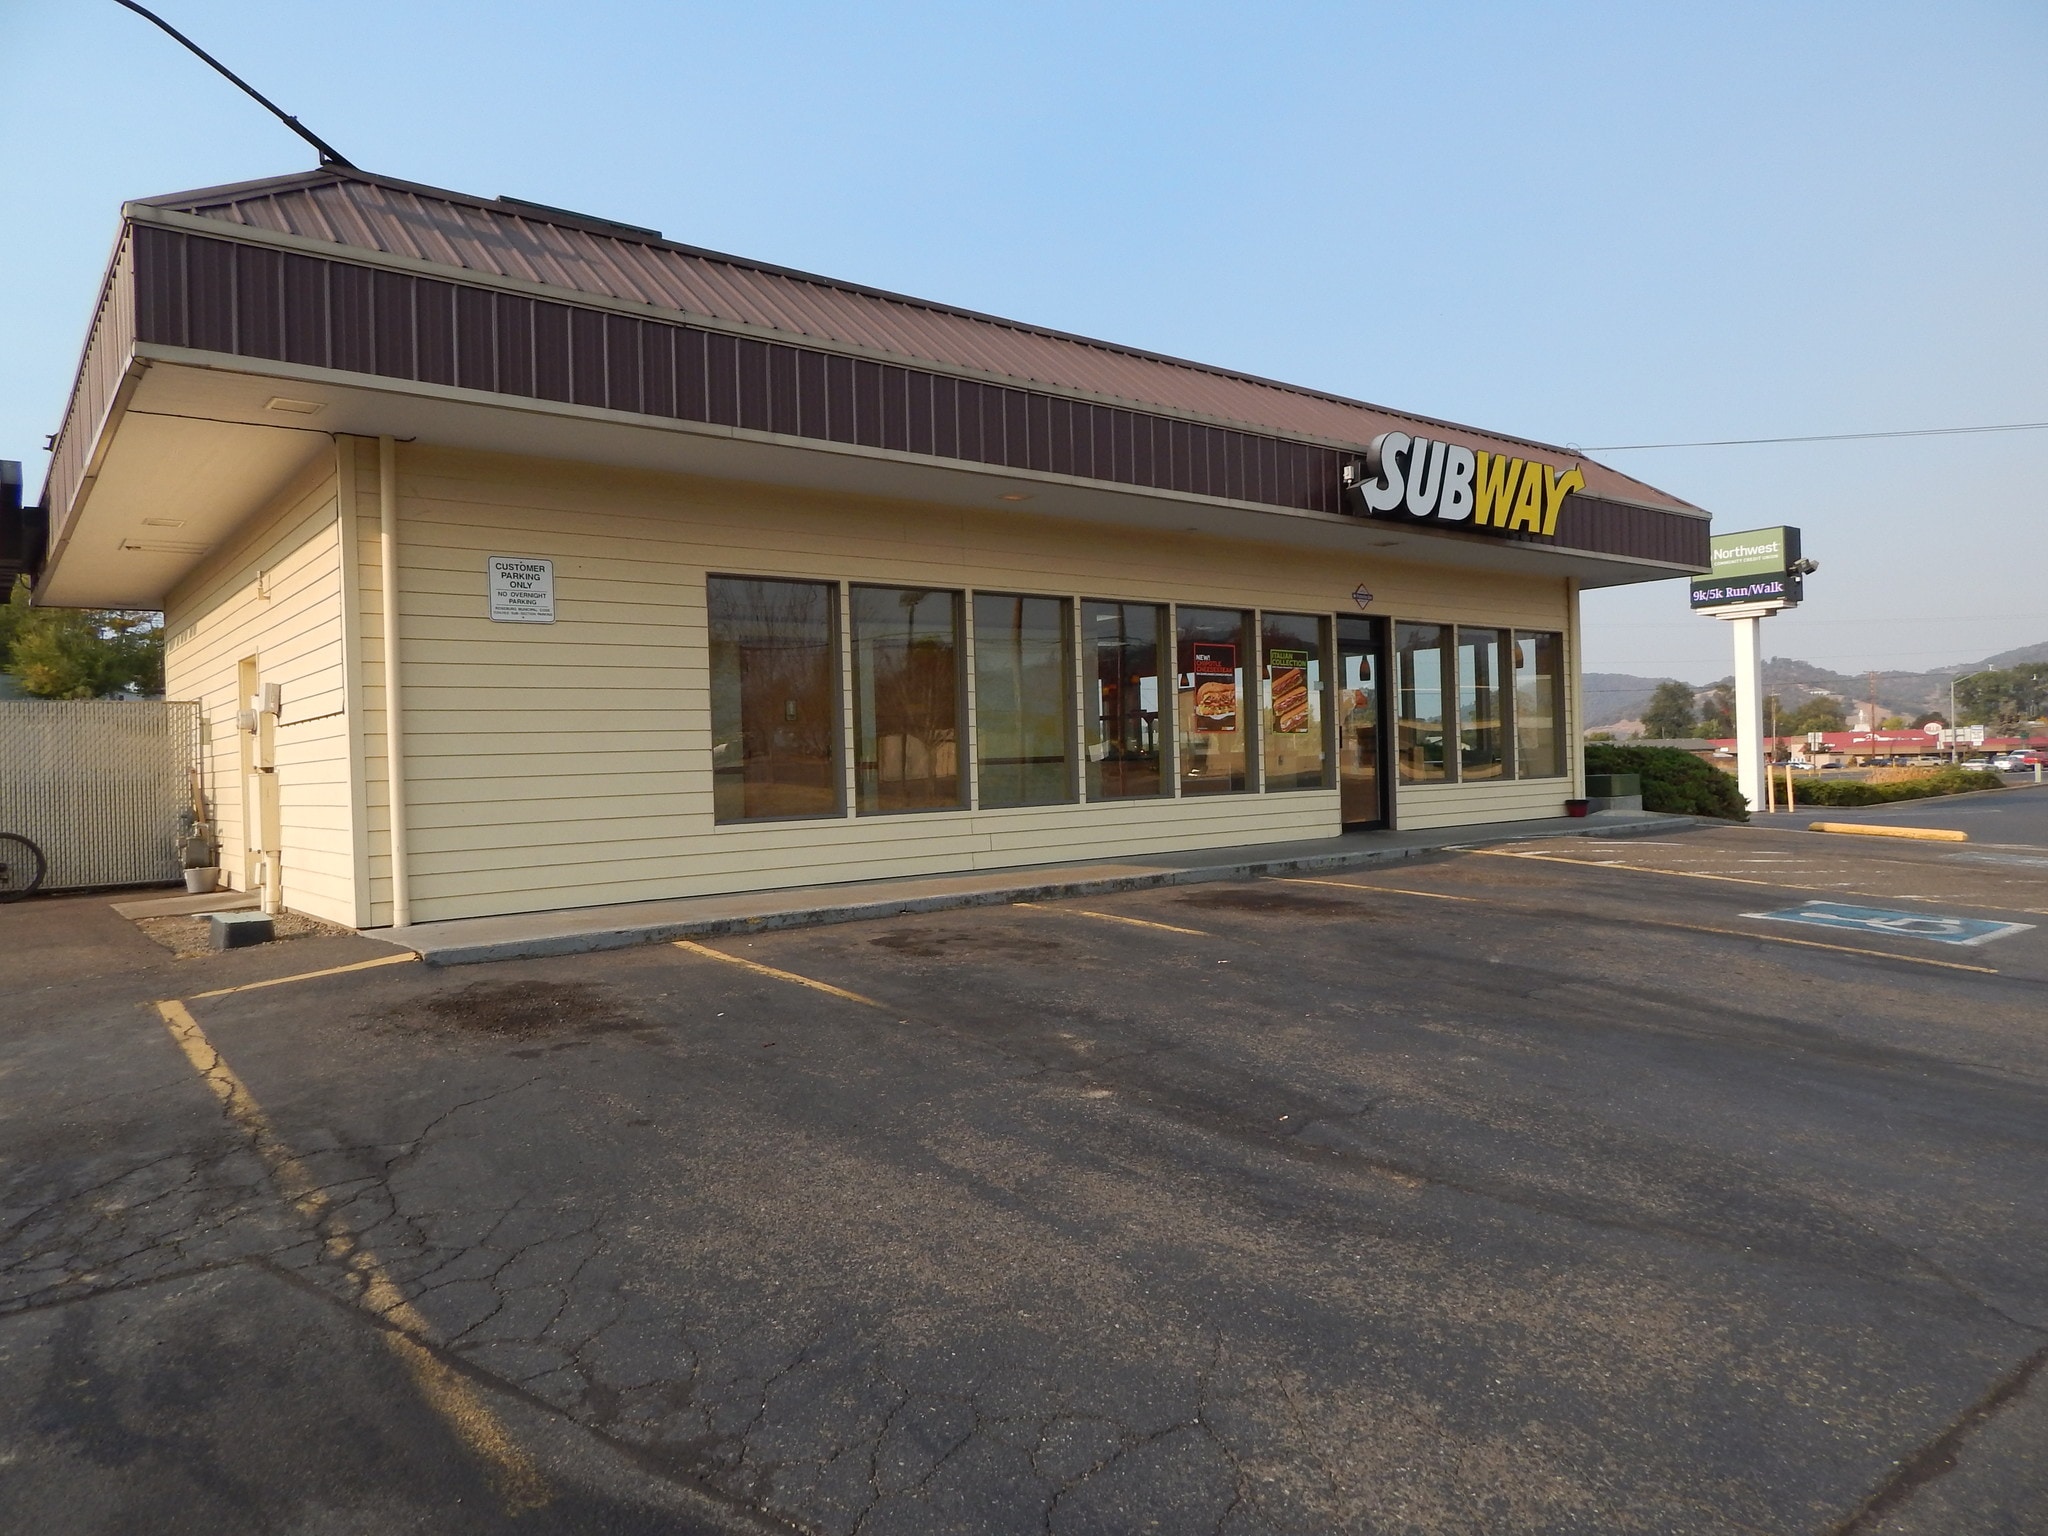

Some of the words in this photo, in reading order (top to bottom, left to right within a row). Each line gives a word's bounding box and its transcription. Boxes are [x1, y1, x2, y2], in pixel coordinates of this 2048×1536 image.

[1361, 431, 1586, 536] SUBWAY
[1713, 541, 1779, 560] Northwest
[1713, 558, 1742, 567] COMMUNITY
[1743, 555, 1761, 563] CREDIT
[495, 562, 545, 572] CUSTOMER
[501, 572, 541, 581] PARKING
[509, 581, 533, 589] ONLY
[510, 591, 546, 599] OVERNIGHT
[1692, 587, 1724, 601] 9k/5k
[1725, 581, 1784, 598] Run/Walk
[1272, 659, 1307, 667] COLLECTION
